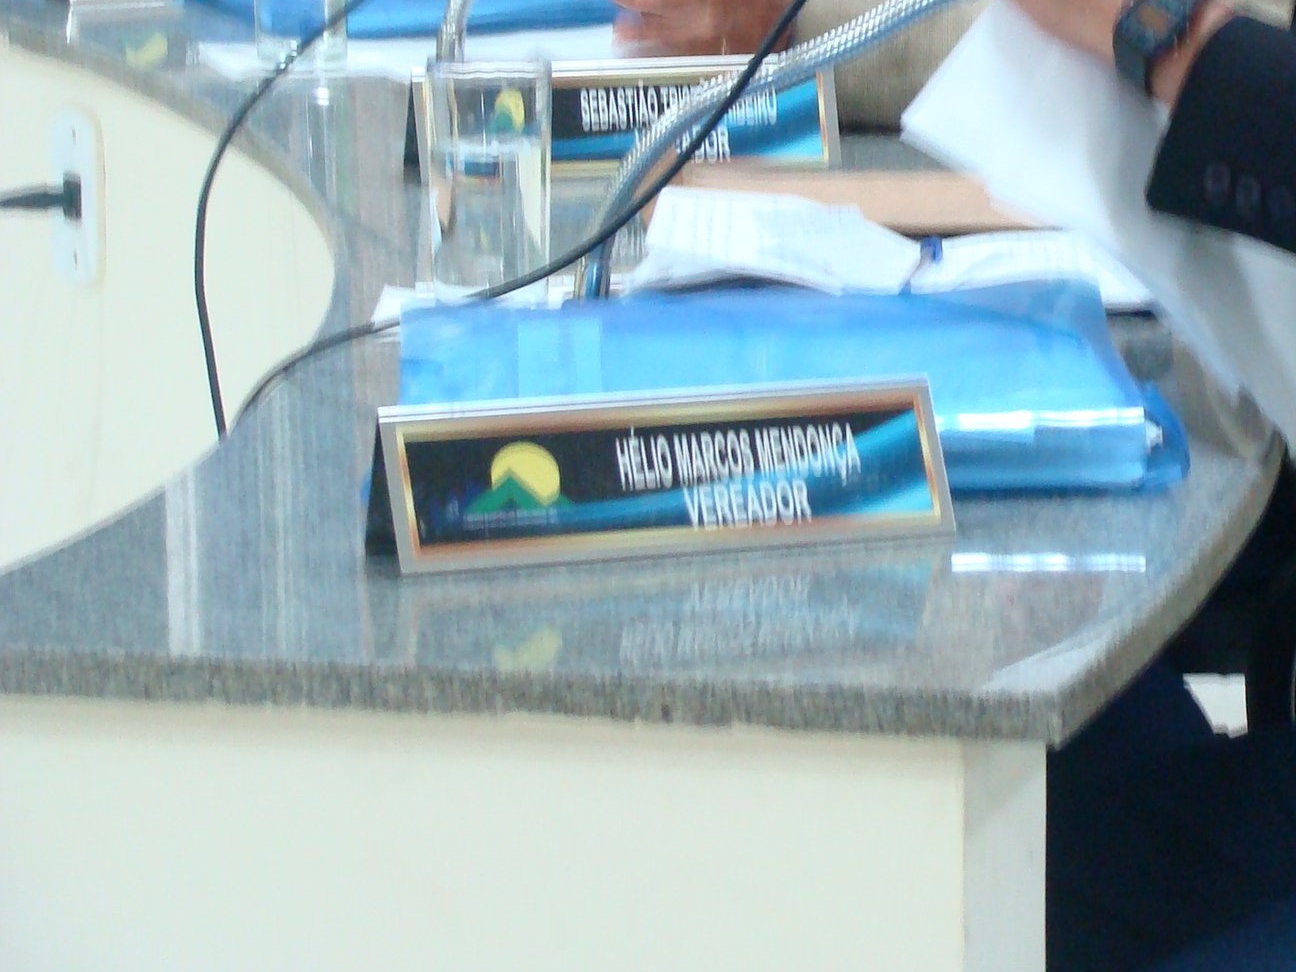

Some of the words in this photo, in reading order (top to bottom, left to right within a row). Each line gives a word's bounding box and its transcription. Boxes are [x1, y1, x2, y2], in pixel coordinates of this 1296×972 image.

[615, 425, 673, 491] HÉLIO
[673, 428, 754, 485] MARCOS
[754, 421, 861, 487] MENDONÇA
[682, 478, 812, 532] VEREADOR
